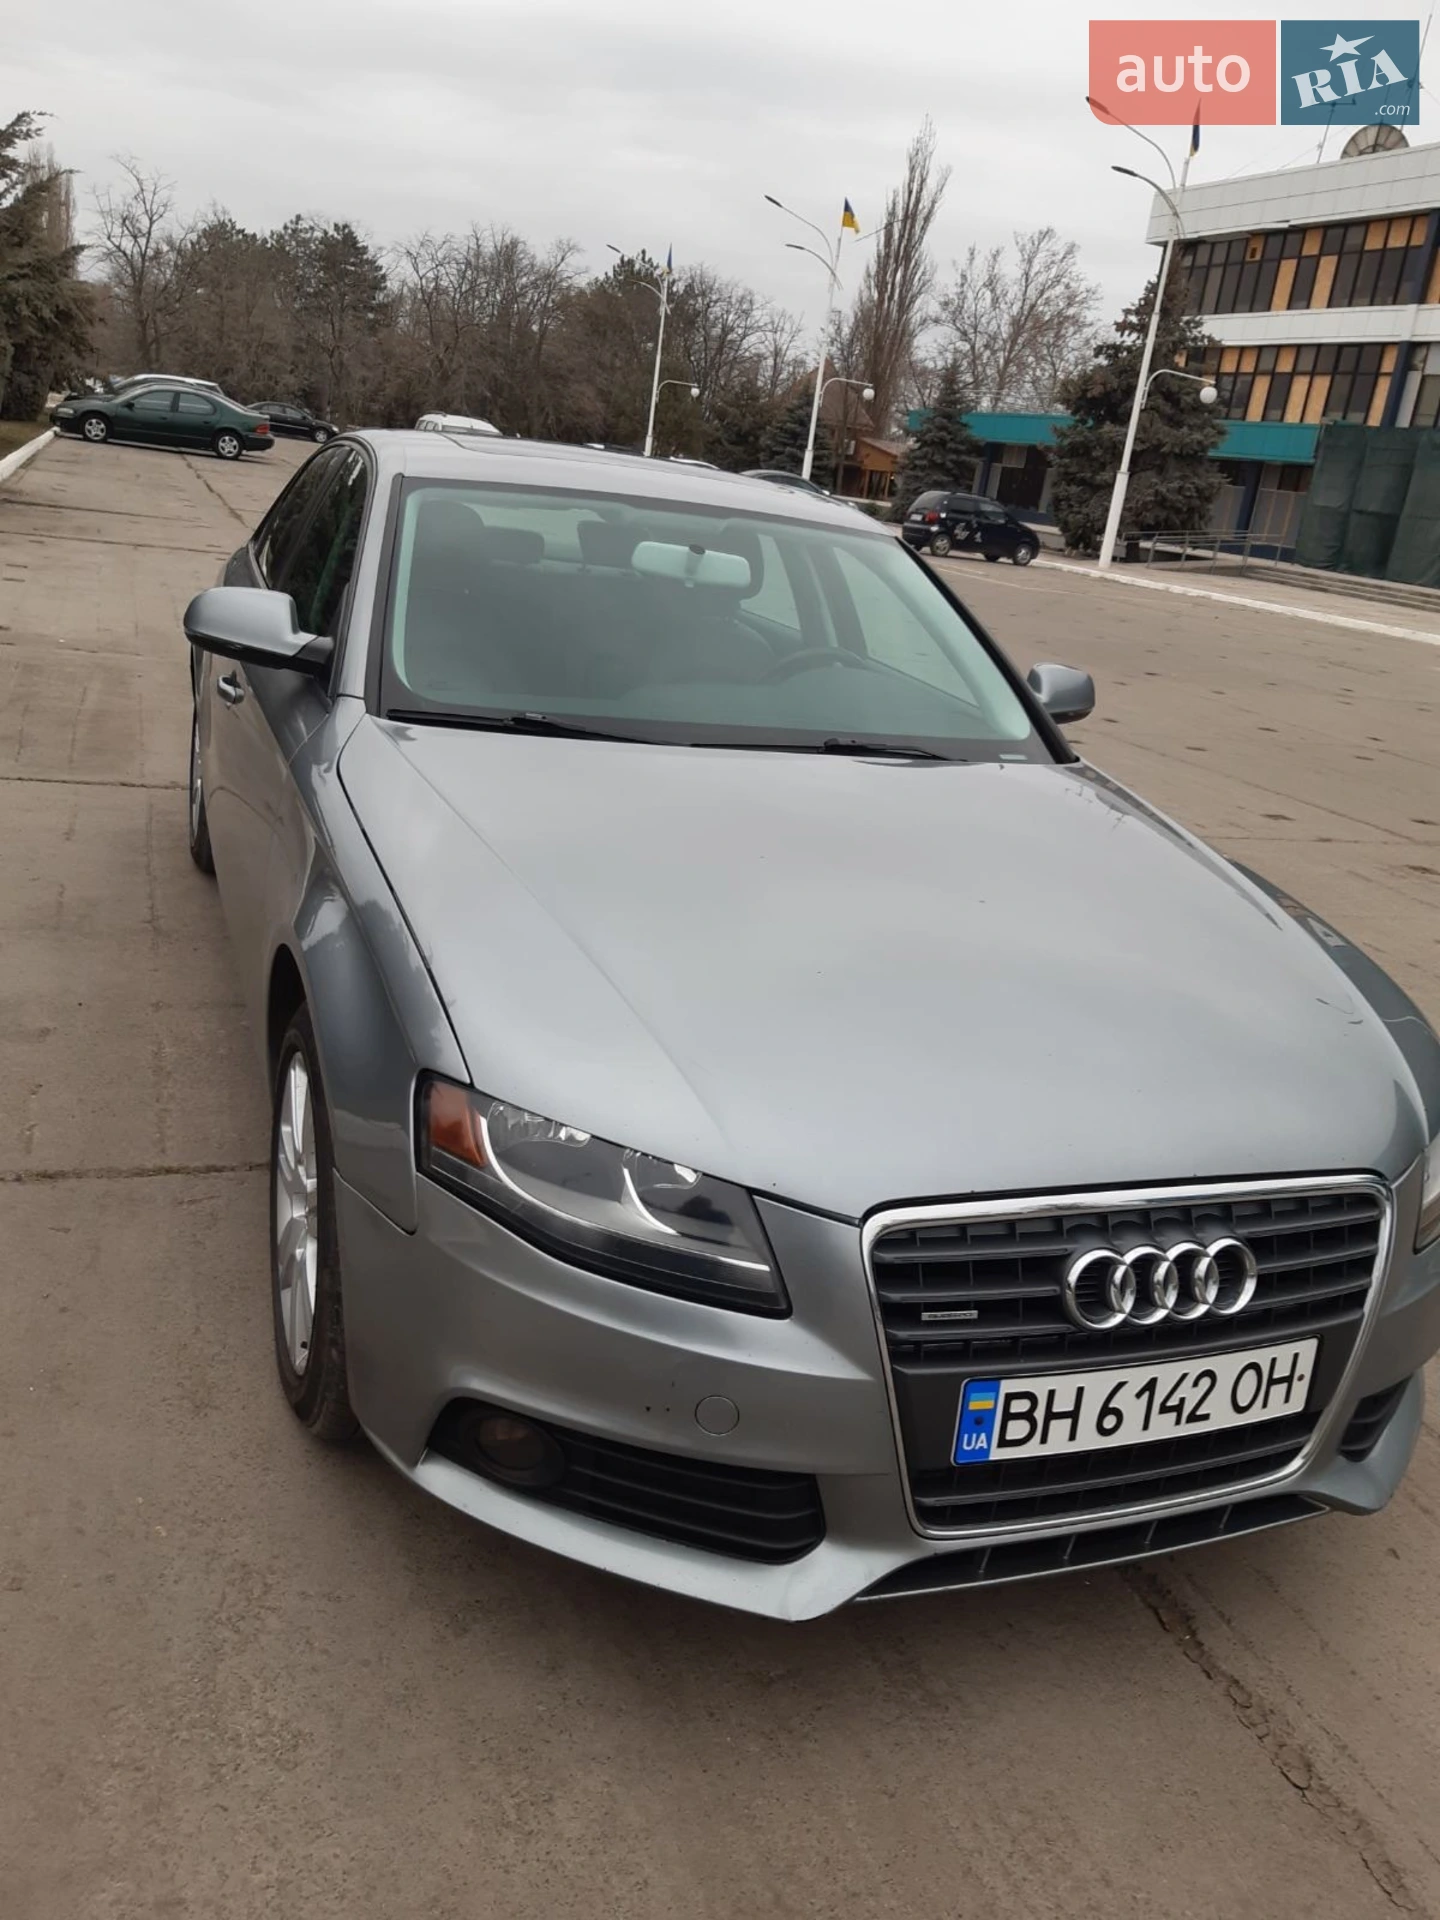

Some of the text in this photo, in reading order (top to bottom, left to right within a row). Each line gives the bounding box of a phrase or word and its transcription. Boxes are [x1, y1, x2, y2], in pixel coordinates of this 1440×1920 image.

[996, 1352, 1301, 1449] BH 6142 OH
[962, 1432, 988, 1451] UA
